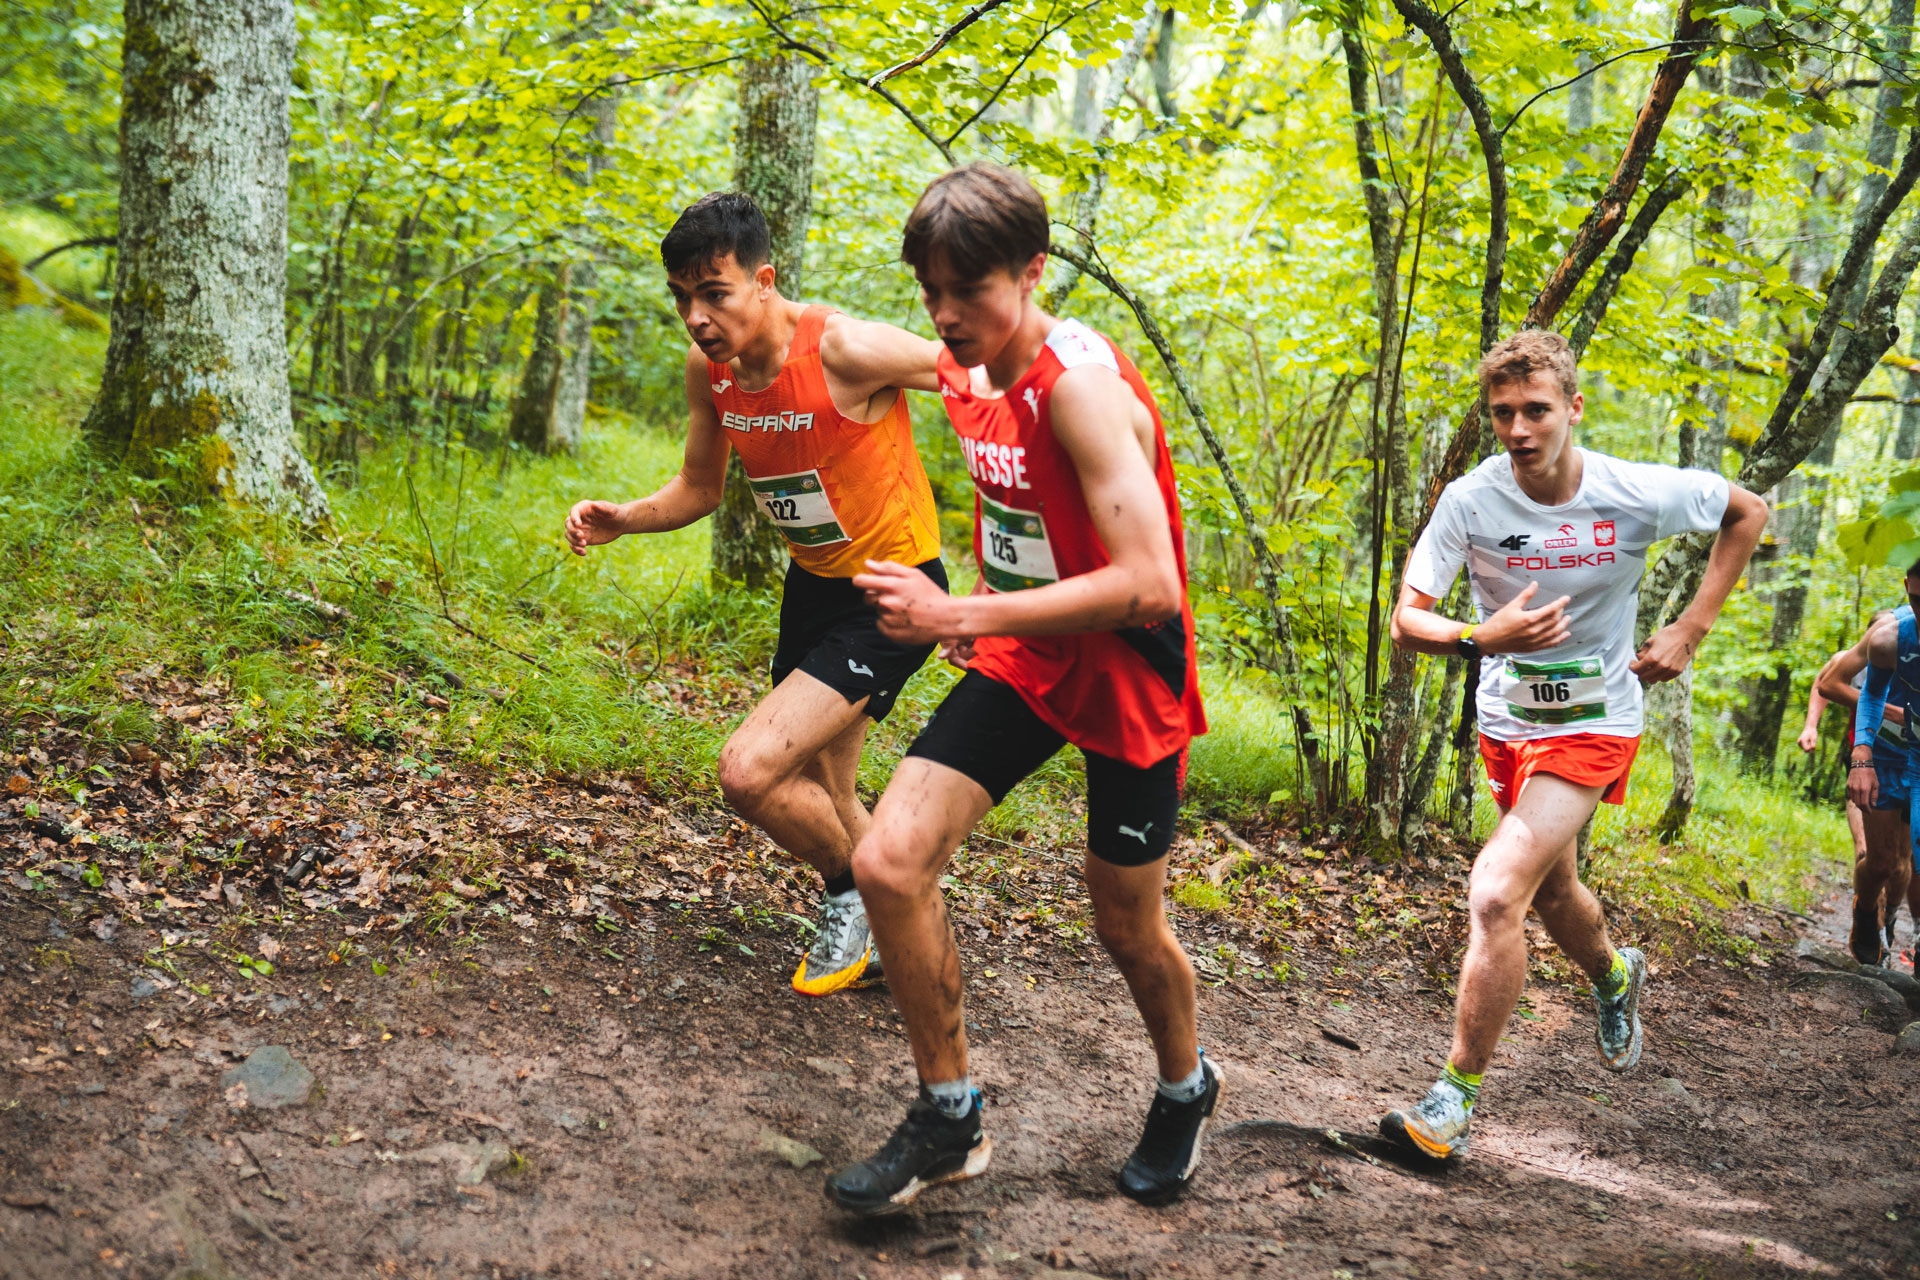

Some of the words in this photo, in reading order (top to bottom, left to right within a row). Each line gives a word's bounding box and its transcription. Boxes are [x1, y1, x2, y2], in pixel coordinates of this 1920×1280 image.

[721, 410, 814, 433] ESPAÑA
[765, 498, 801, 521] 122
[989, 531, 1018, 565] 125
[1498, 535, 1531, 551] 4F
[1546, 539, 1576, 548] ORLEN
[1507, 551, 1616, 571] POLSKA
[1529, 682, 1570, 703] 106
